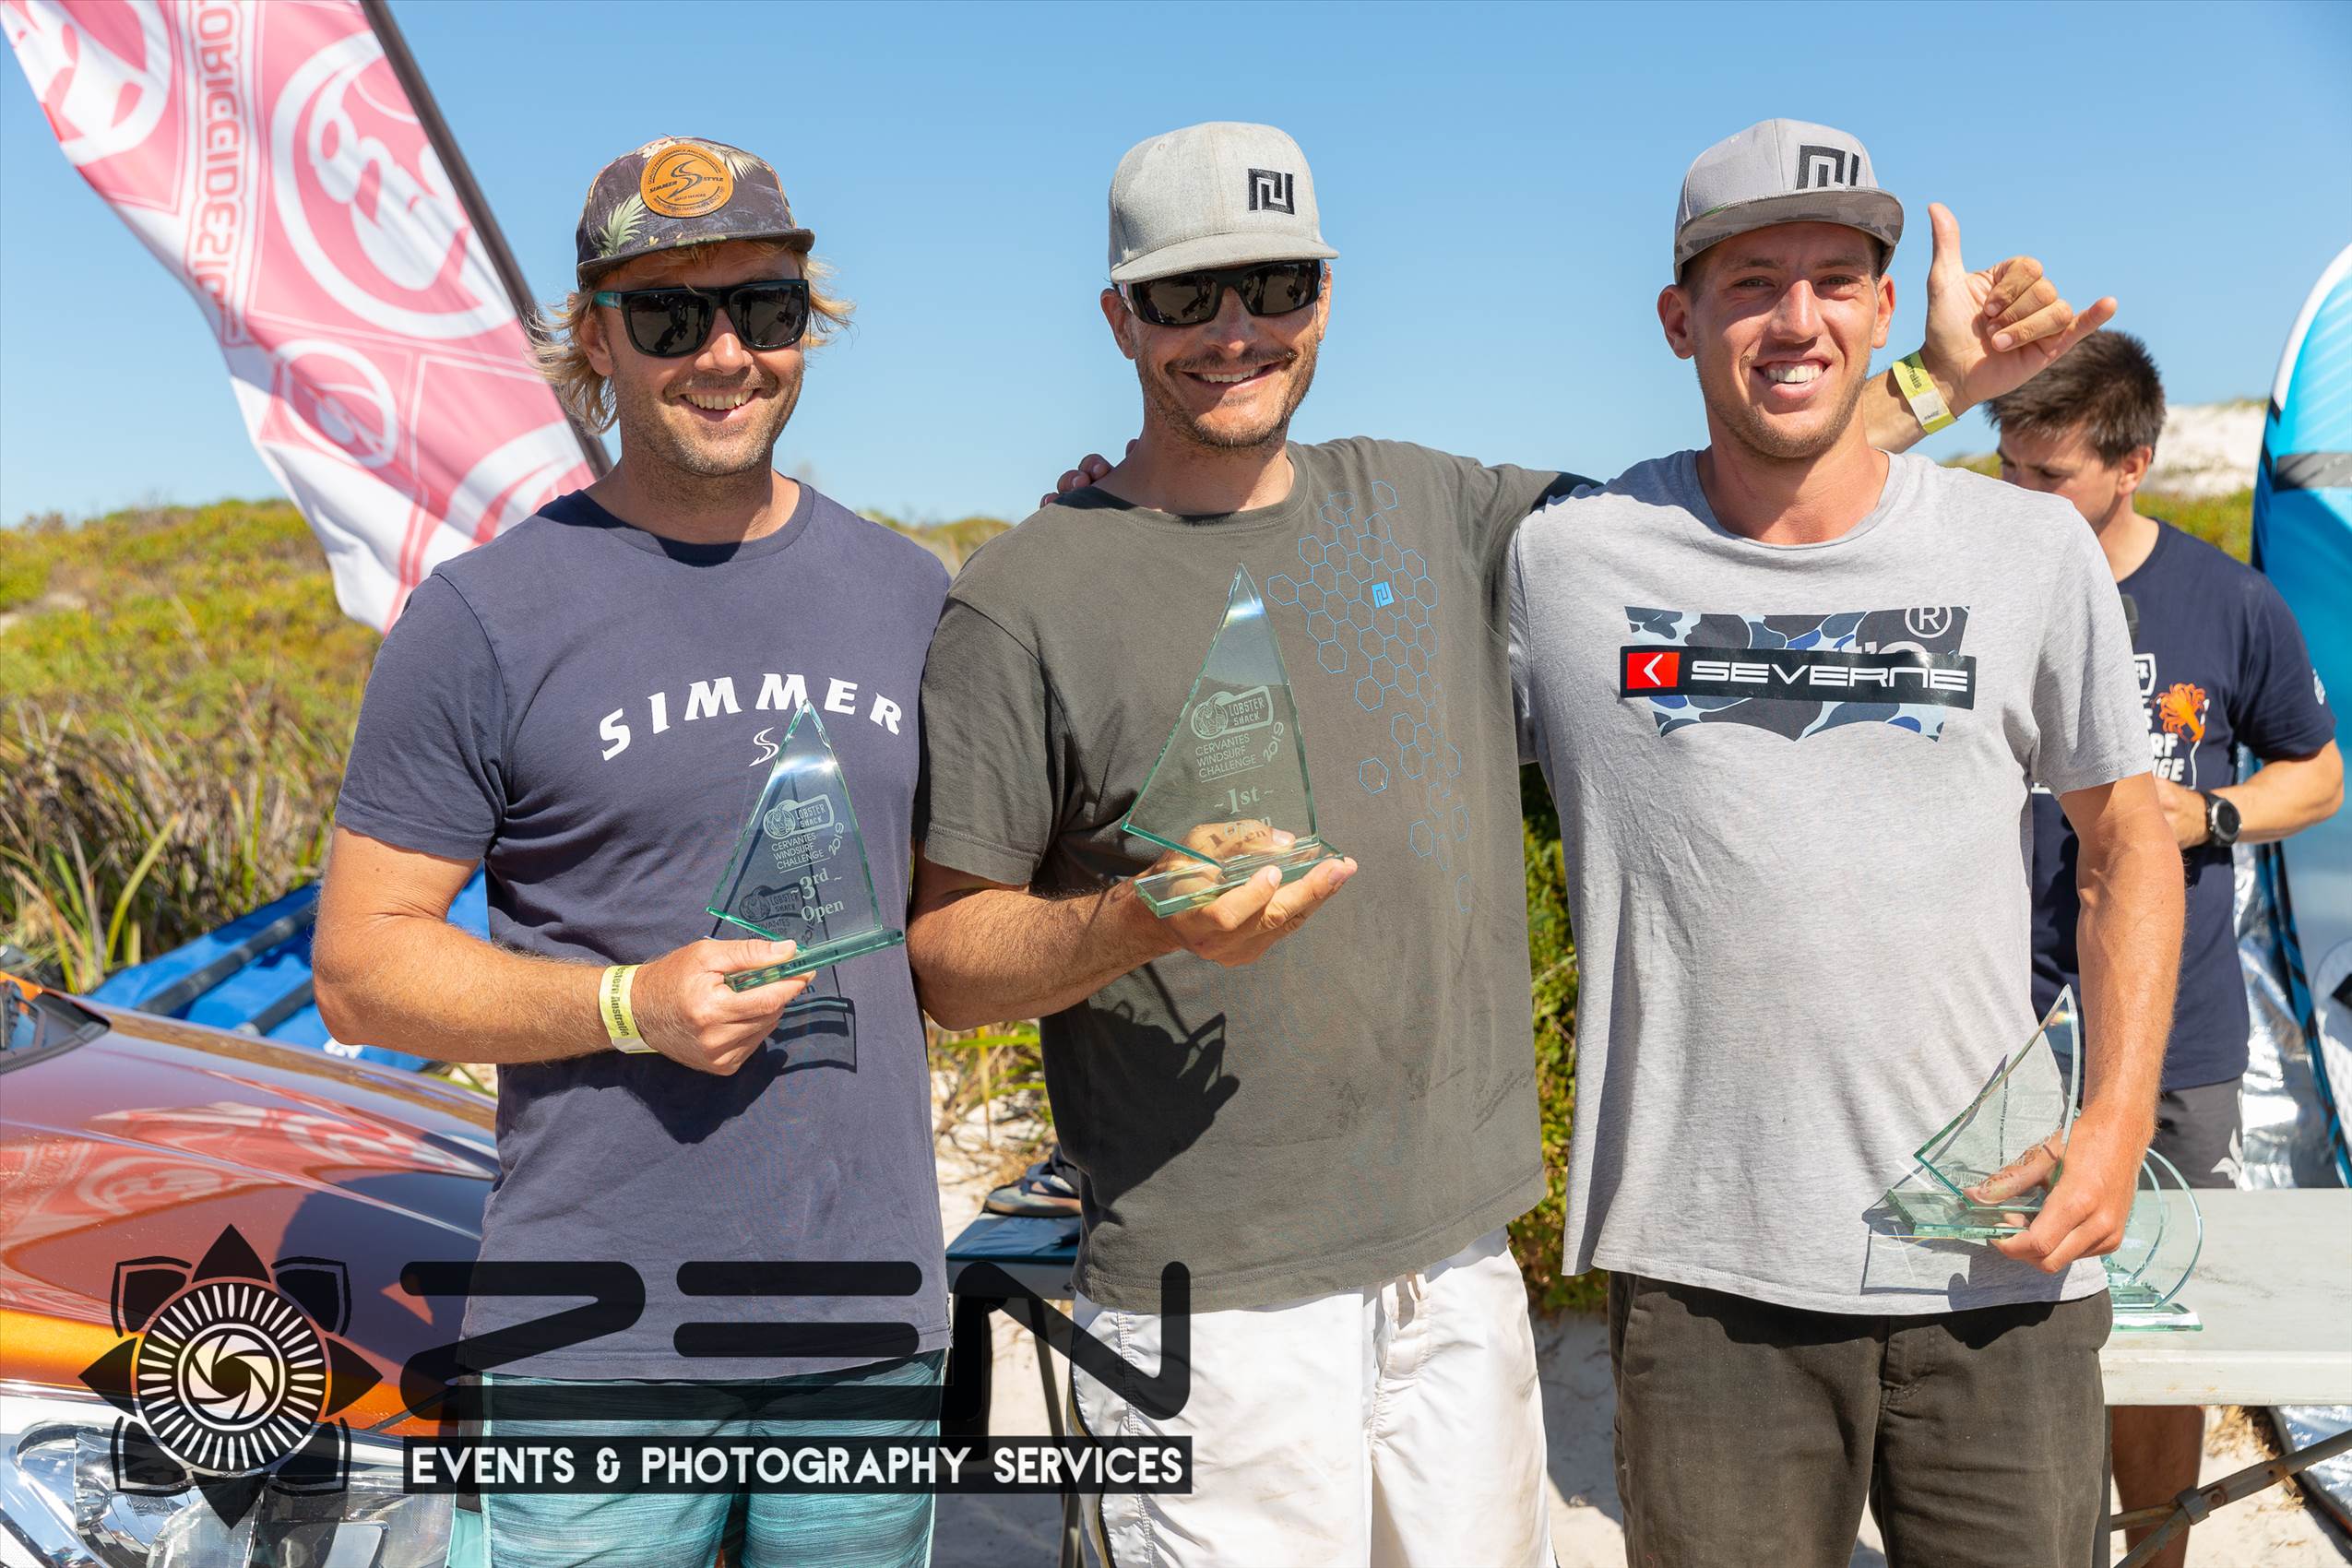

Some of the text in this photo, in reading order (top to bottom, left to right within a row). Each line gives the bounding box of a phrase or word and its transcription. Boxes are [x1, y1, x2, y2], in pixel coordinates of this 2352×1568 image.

[649, 181, 678, 194] SIMMER
[1691, 659, 1968, 692] SEVERNE
[600, 673, 902, 761] SIMMER
[1229, 697, 1265, 717] LOBSTER
[1233, 711, 1261, 726] SHACK
[1195, 733, 1251, 756] CERVANTES
[1197, 745, 1246, 767] WINDSURF
[1199, 754, 1257, 778] CHALLENGE
[794, 803, 826, 820] LOBSTER
[800, 815, 823, 828] SHACK
[771, 832, 817, 852] CERVANTES
[773, 842, 814, 861] WINDSURF
[777, 849, 825, 870] CHALLENGE
[801, 900, 845, 923] Open
[611, 996, 630, 1037] Australia
